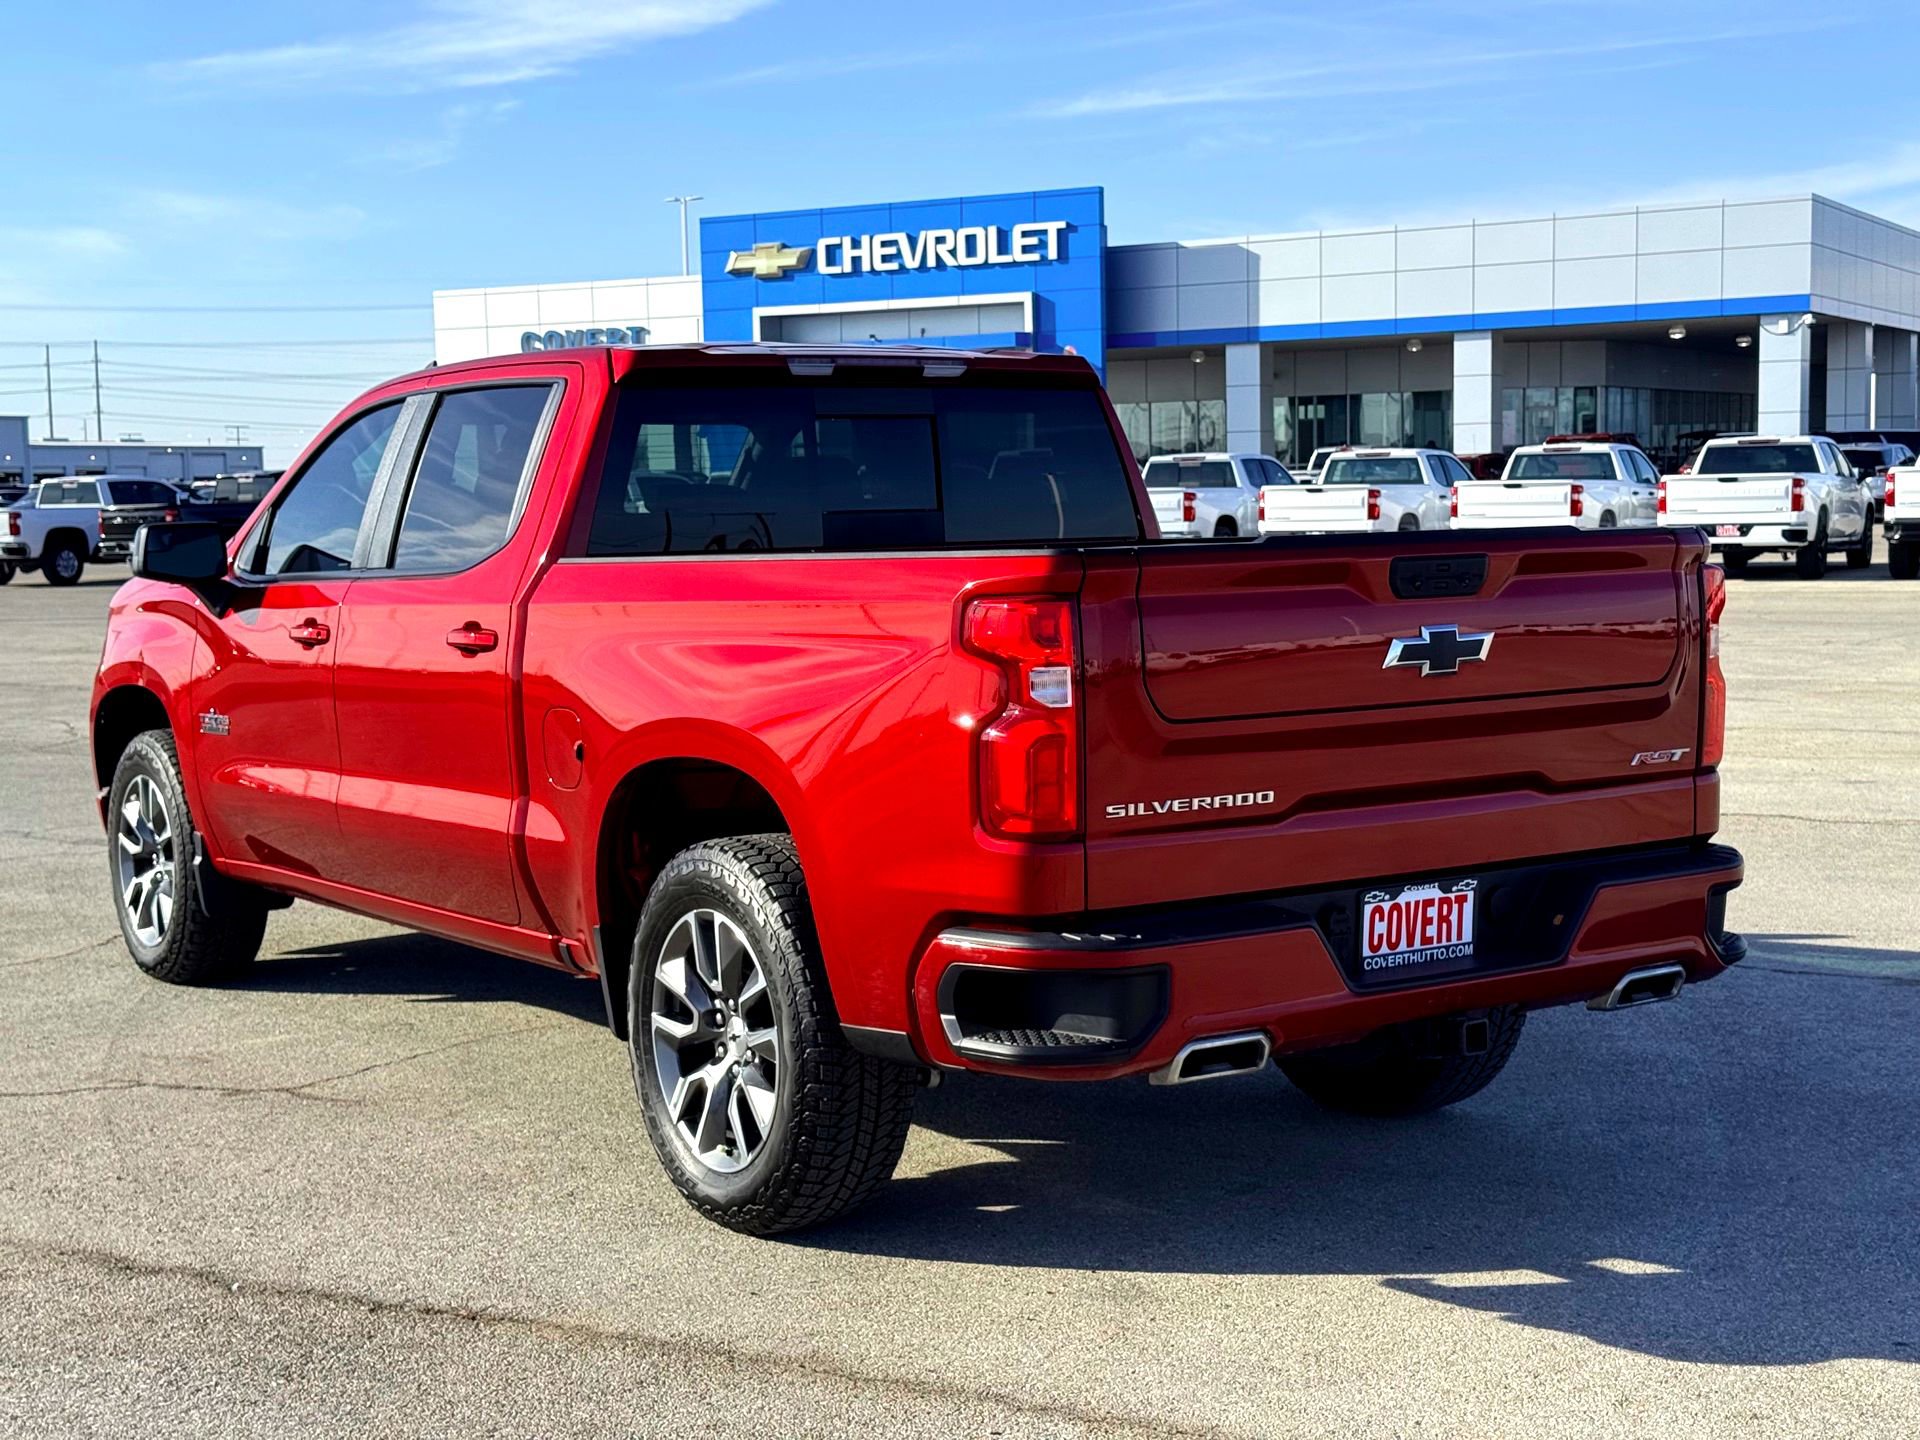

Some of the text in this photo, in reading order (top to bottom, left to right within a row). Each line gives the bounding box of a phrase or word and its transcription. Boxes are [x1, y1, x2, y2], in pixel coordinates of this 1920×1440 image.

[817, 220, 1067, 275] CHEVROLET
[521, 326, 651, 353] COVERT
[1631, 747, 1691, 766] RST
[1105, 790, 1275, 818] SILVERADO
[1404, 882, 1439, 892] Covert
[1368, 894, 1469, 954] COVERT
[1364, 943, 1474, 970] COVERTHUTTO.COM
